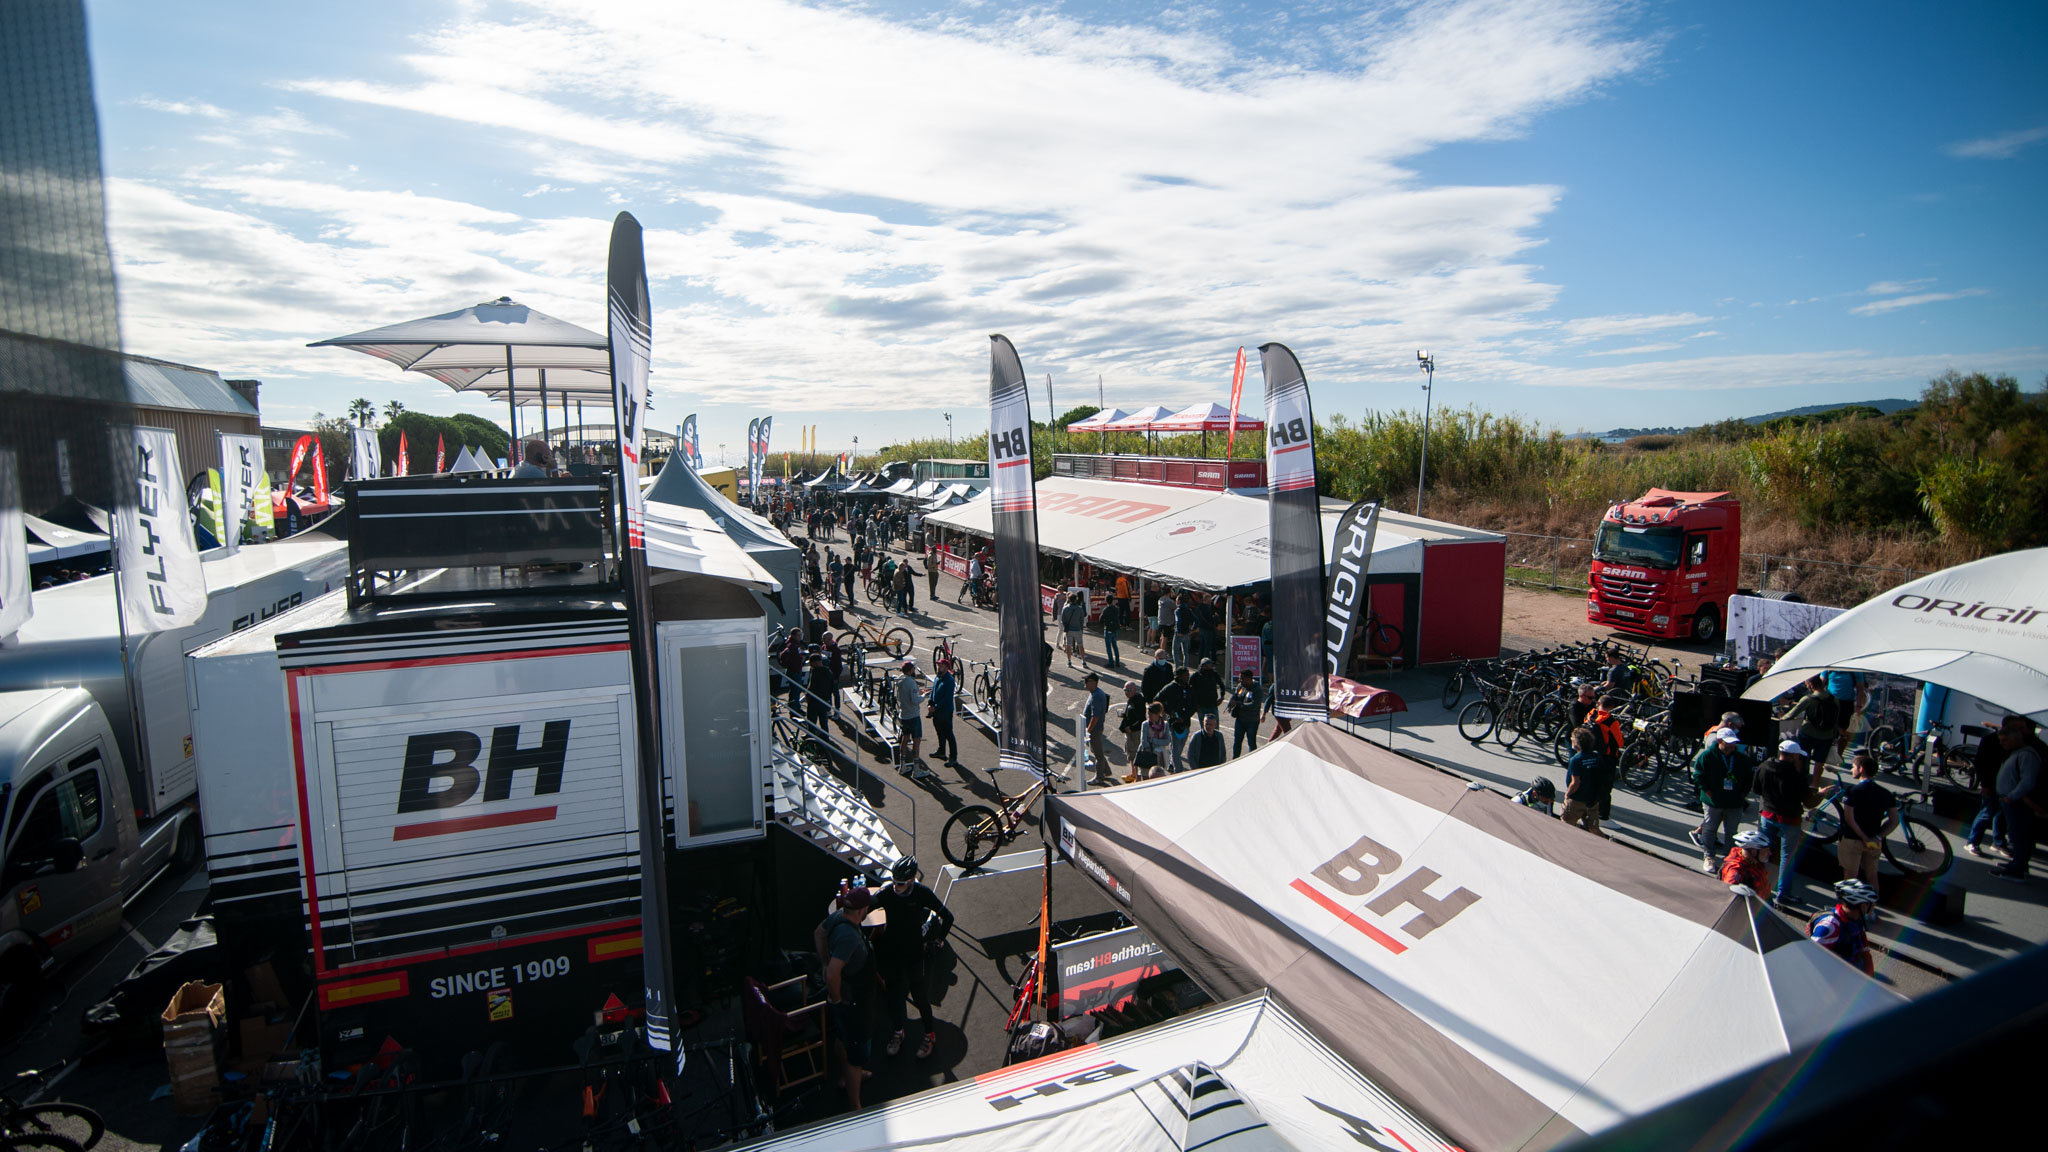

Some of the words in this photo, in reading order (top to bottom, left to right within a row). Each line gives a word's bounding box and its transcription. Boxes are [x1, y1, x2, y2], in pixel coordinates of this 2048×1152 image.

[1197, 471, 1220, 479] SRAM
[137, 444, 175, 616] FLYER
[1602, 566, 1647, 579] SRAM
[397, 719, 572, 815] BH
[1062, 827, 1074, 844] BH
[1310, 835, 1483, 940] BH
[430, 965, 506, 999] SINCE
[512, 955, 571, 984] 1909
[988, 1063, 1139, 1111] BH
